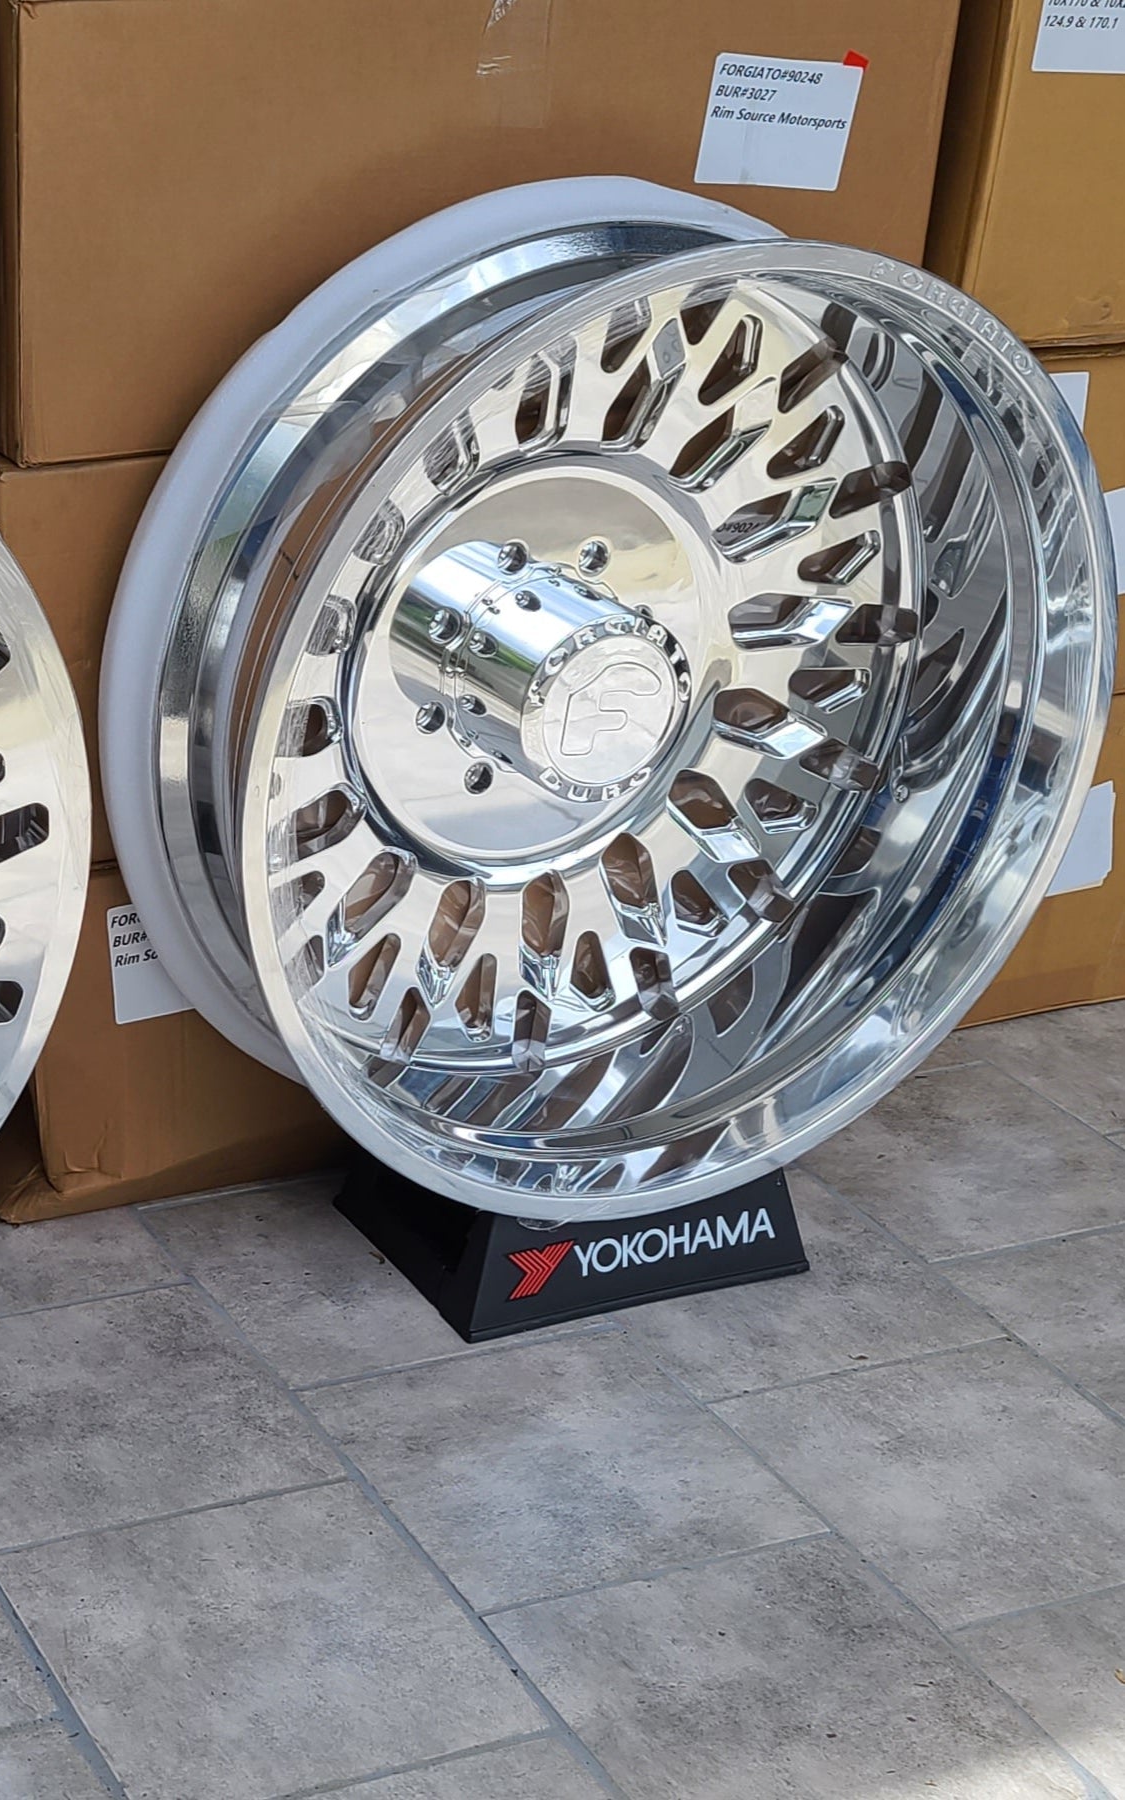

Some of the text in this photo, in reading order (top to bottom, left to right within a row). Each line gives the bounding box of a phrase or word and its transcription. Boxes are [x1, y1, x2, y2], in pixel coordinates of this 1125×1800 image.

[1044, 15, 1119, 29] 124.9 & 170.1
[719, 63, 823, 85] FORGIATO#90248
[715, 84, 777, 102] BUR#3027
[710, 106, 847, 131] Rim Source Motorsports
[870, 260, 1034, 376] FORGIATO
[527, 613, 692, 708] FORGIATO
[114, 953, 140, 968] Rim
[574, 1208, 776, 1277] YOKOHAMA
